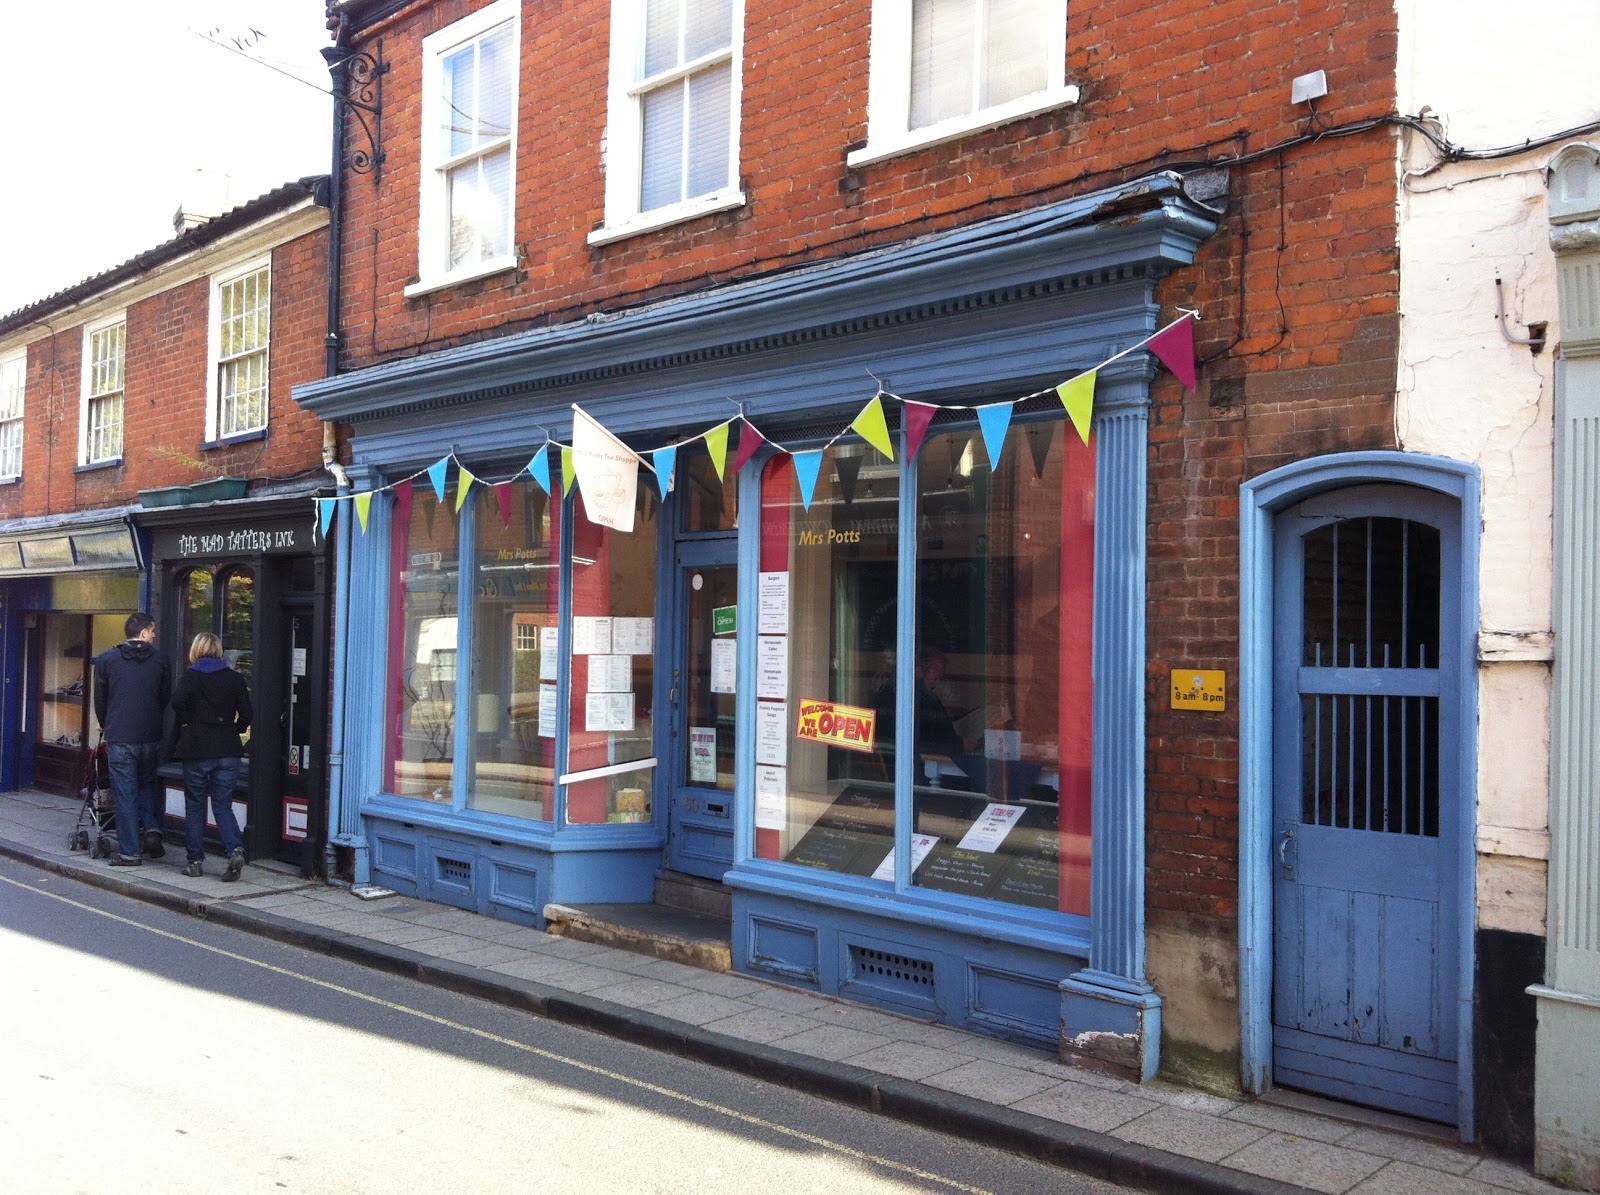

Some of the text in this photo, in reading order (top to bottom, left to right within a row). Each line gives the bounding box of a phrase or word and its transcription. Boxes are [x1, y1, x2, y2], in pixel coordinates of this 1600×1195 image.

[589, 450, 603, 459] Potts
[615, 455, 638, 465] Shoppe
[598, 514, 614, 525] OPEN
[179, 529, 295, 557] THE MAD TATTERS INK
[798, 529, 861, 545] Mrs Potts
[497, 547, 537, 560] Mrs Potts
[717, 617, 734, 625] OPEN
[801, 704, 834, 717] WELCOME
[804, 717, 817, 728] WE
[818, 712, 872, 743] OPEN
[800, 726, 818, 738] ARE
